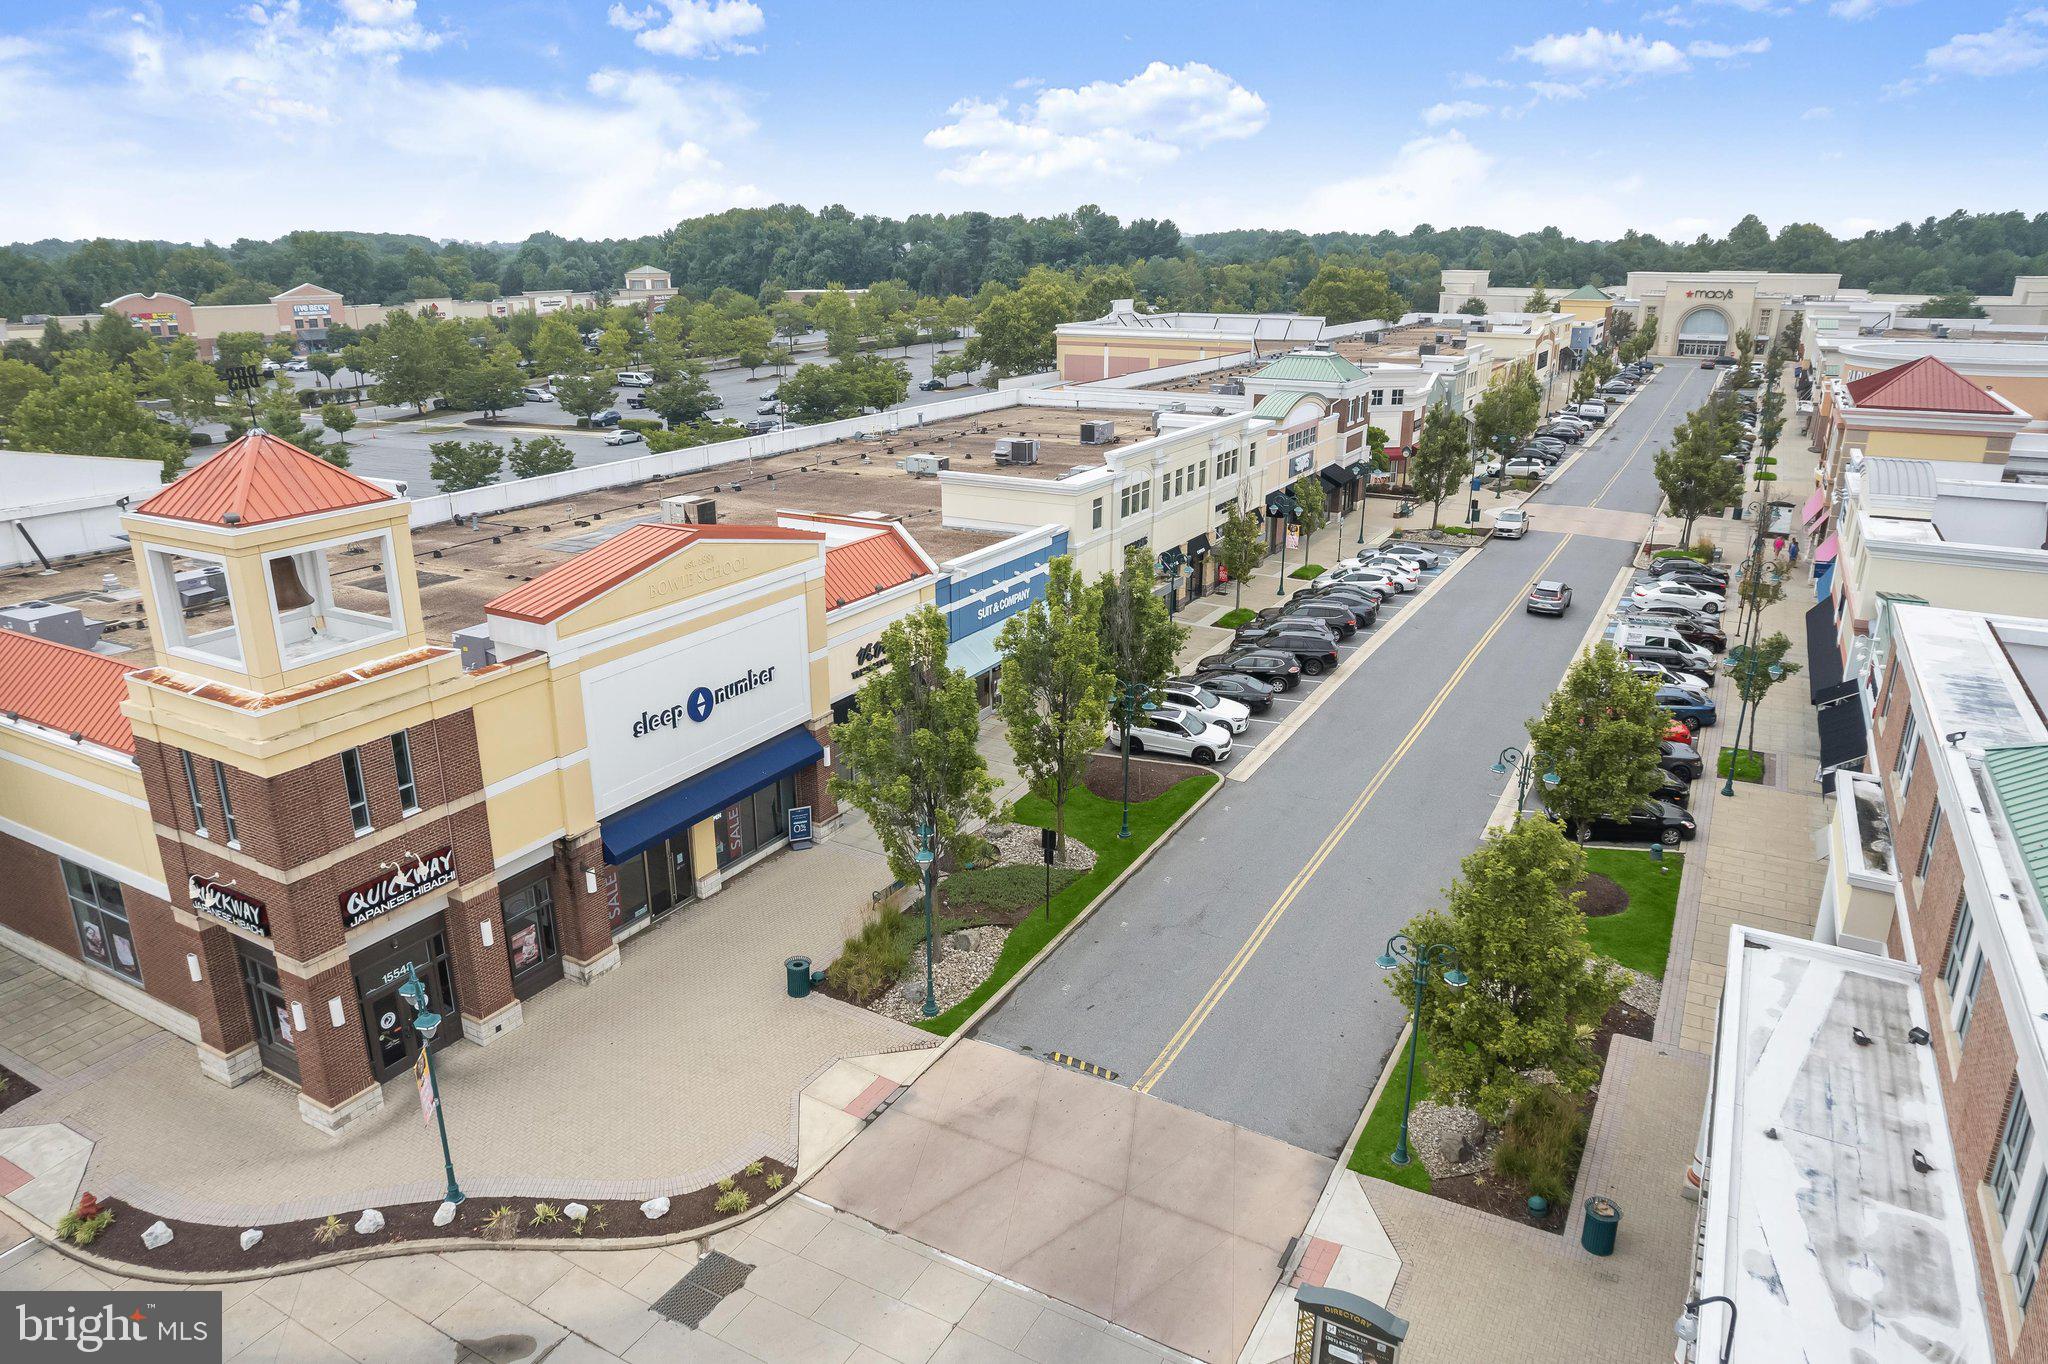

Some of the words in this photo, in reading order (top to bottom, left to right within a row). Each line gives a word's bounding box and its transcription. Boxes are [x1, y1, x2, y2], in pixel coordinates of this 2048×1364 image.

[1694, 288, 1734, 301] macy's
[648, 573, 694, 600] BOWIE
[696, 557, 749, 585] SCHOOL
[977, 603, 993, 620] SUIT
[993, 601, 1000, 614] &
[1000, 587, 1031, 611] COMPANY
[633, 704, 683, 738] sleep
[714, 665, 776, 705] number
[728, 807, 742, 850] SALE
[346, 849, 453, 915] QUICKWAY
[350, 890, 413, 928] JAPANESE
[412, 870, 456, 898] HIBACHI
[604, 872, 621, 920] SALE
[1324, 1306, 1372, 1328] DIRECTORY
